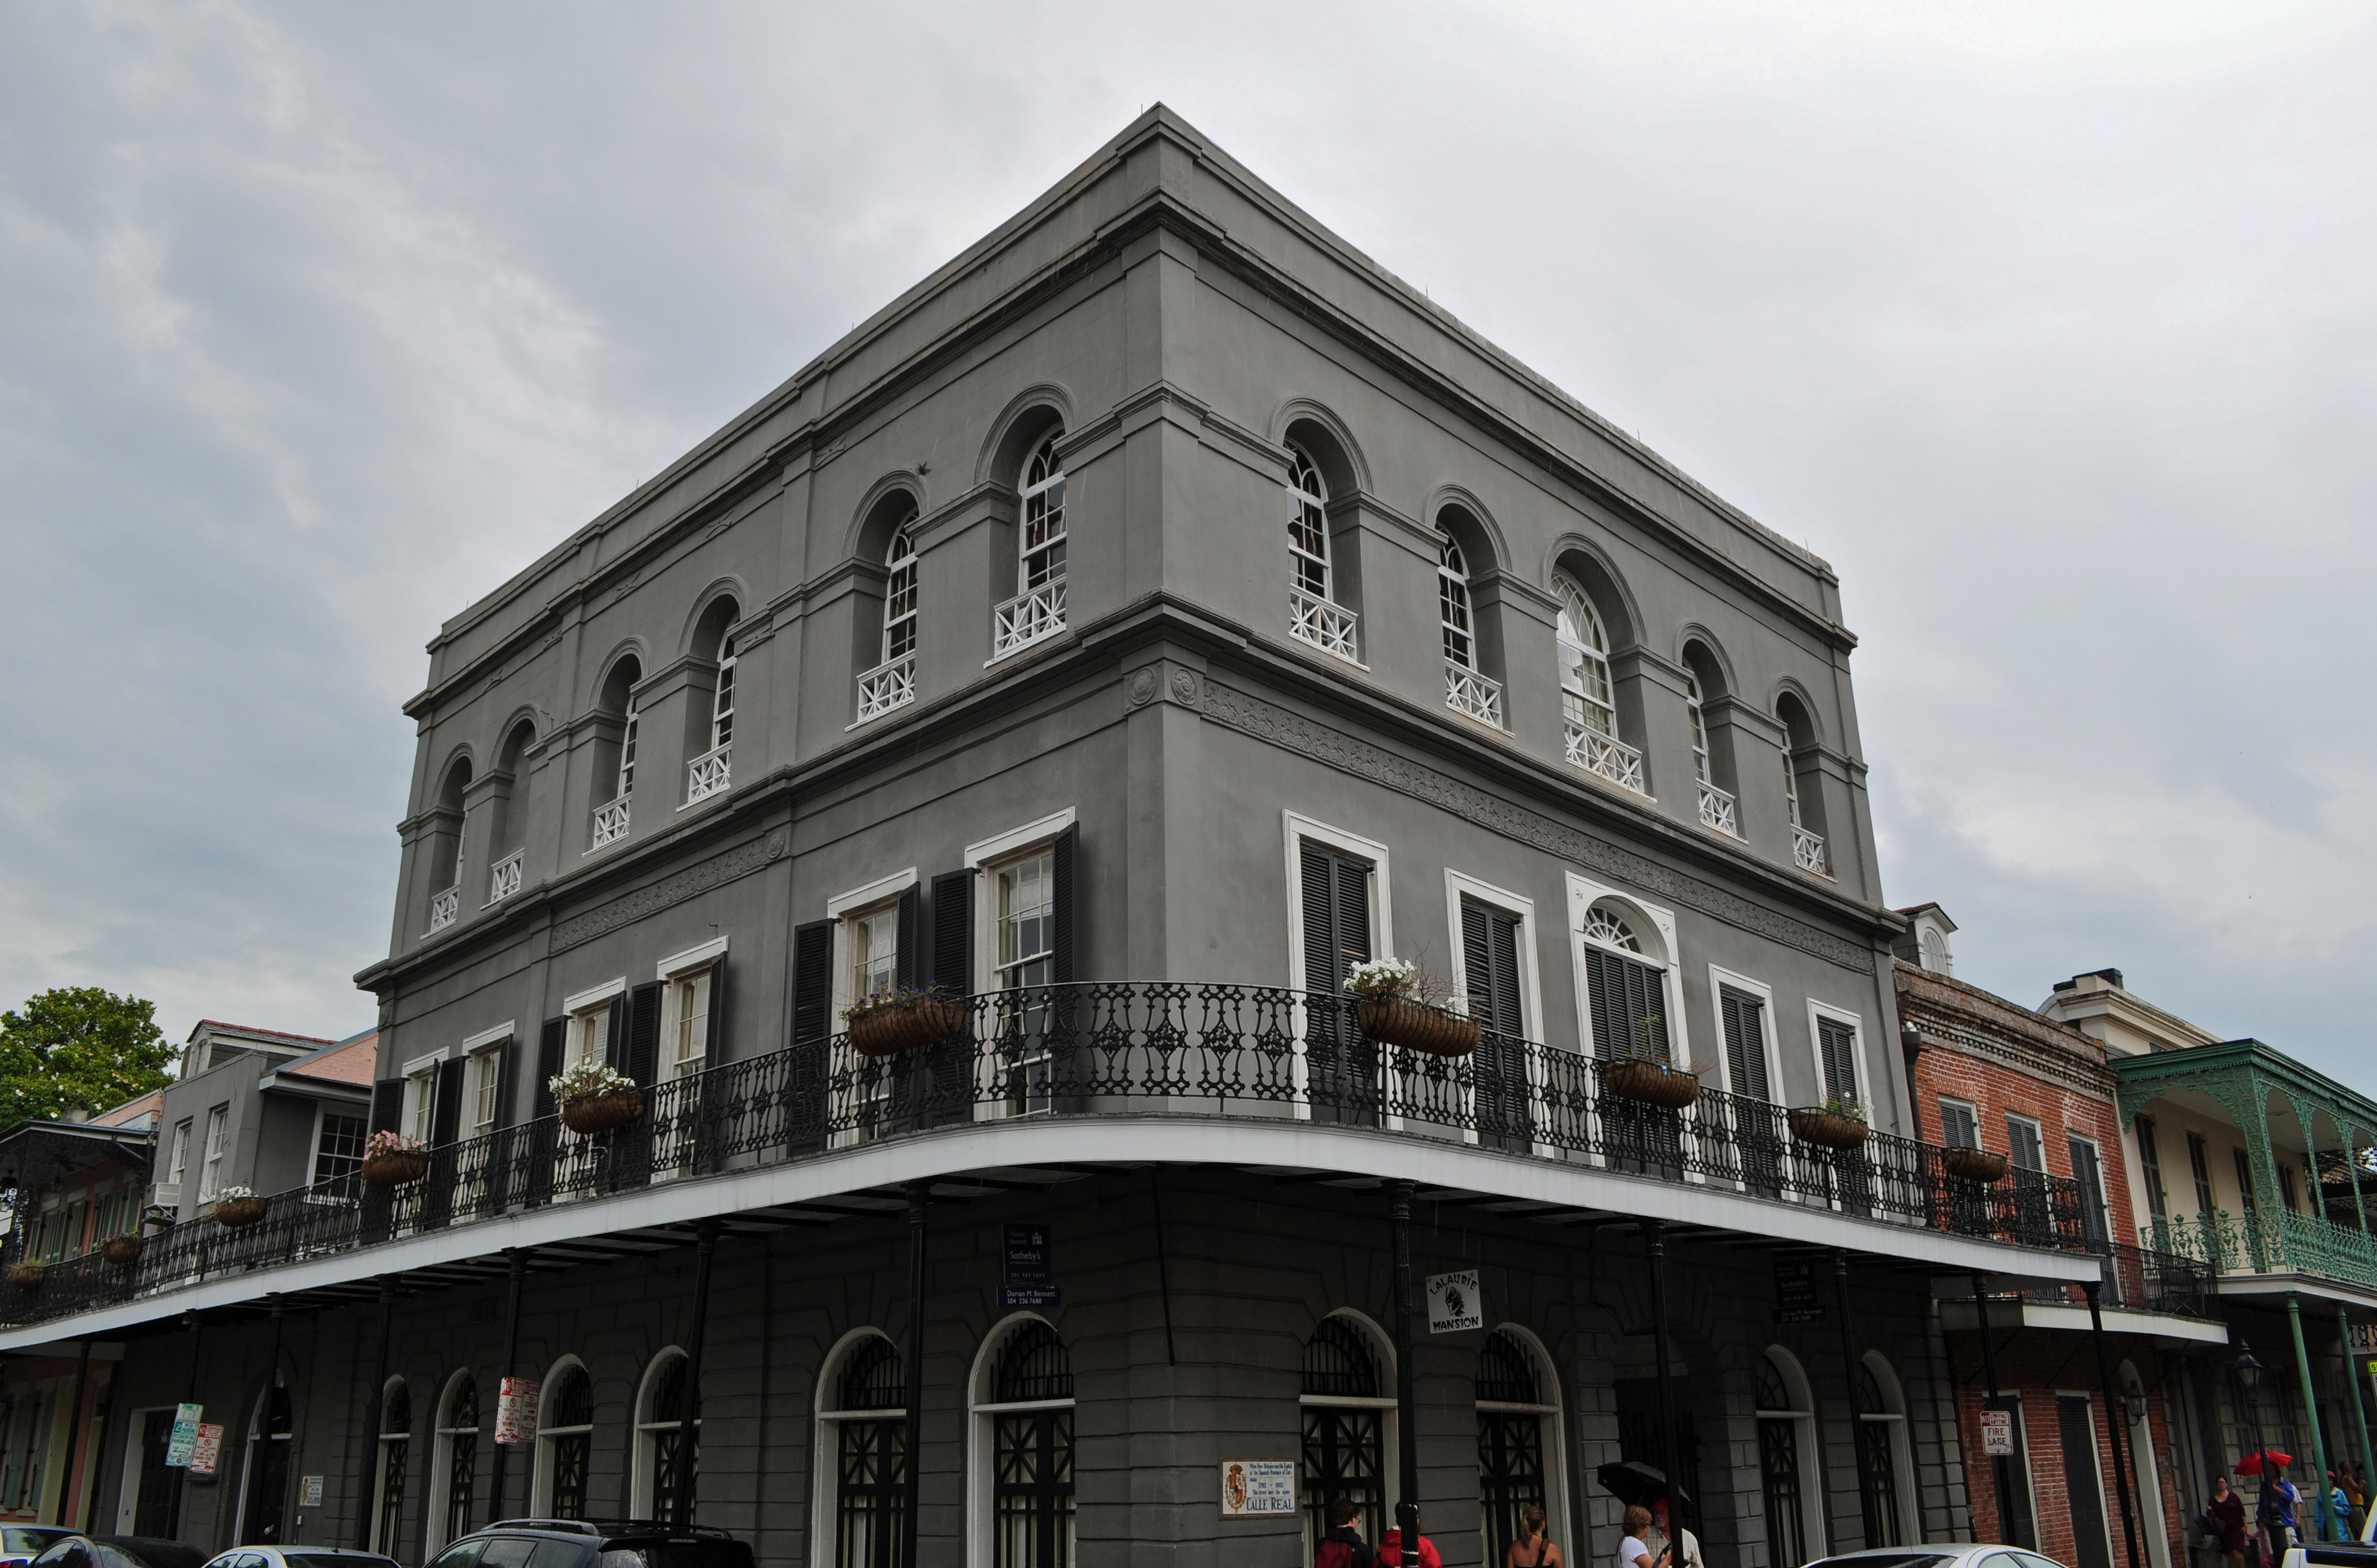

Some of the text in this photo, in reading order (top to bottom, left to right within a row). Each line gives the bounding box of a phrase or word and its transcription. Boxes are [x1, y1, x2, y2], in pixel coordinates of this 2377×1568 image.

[1010, 1251, 1041, 1261] Sotheby's
[1430, 1274, 1477, 1295] LALAURIE
[1433, 1316, 1479, 1332] MANSION
[1981, 1415, 1989, 1424] NO
[1988, 1428, 2005, 1436] FIRE
[1987, 1437, 2007, 1446] LANE
[1247, 1497, 1293, 1510] CALLE REAL
